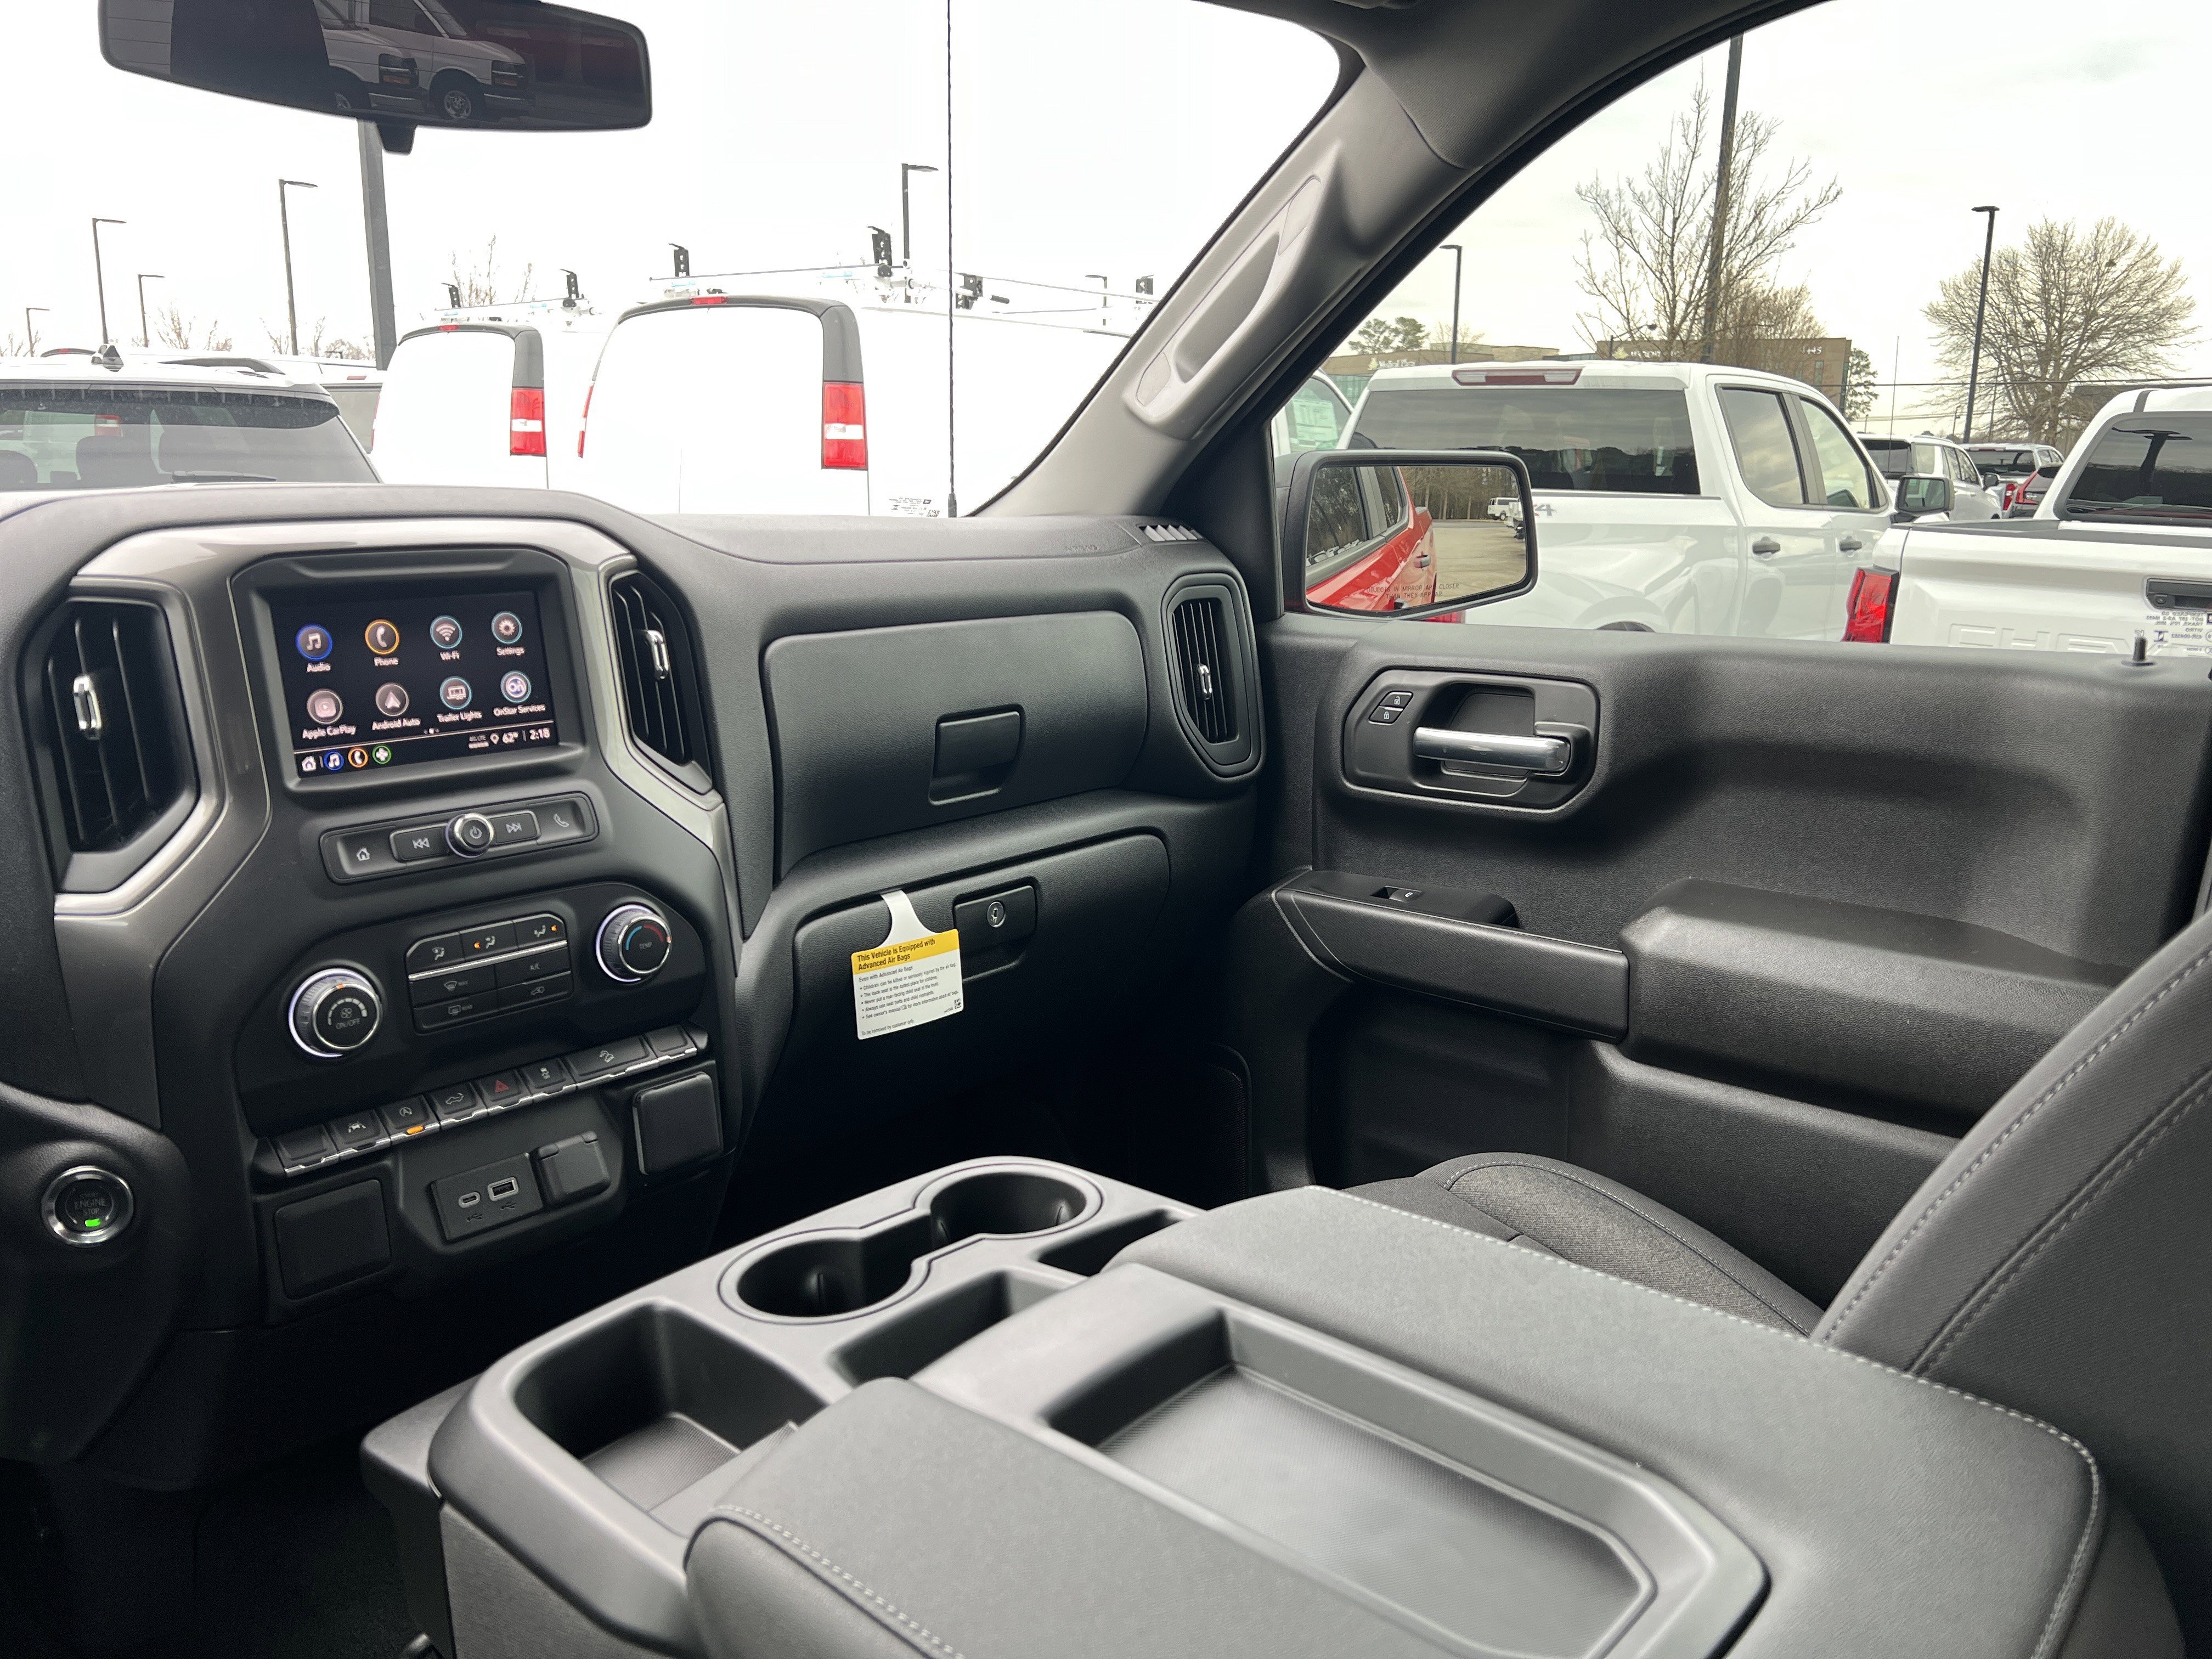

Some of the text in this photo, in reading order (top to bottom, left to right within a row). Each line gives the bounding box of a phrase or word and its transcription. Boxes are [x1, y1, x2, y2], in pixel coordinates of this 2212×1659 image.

[440, 651, 460, 661] Wi-Fi
[496, 646, 526, 657] Settings
[307, 662, 331, 673] Audio
[374, 657, 399, 667] Phone
[437, 710, 483, 723] Trailer Lights
[493, 704, 546, 717] OnStar Services
[372, 718, 421, 730] Android Auto
[302, 724, 357, 740] Apple CarPlay
[502, 731, 518, 744] 62°
[529, 727, 551, 741] 2:18
[639, 941, 653, 950] TEMP
[857, 953, 870, 962] This
[872, 949, 892, 959] Vehicle
[899, 941, 923, 953] Equipped
[924, 938, 936, 947] with
[858, 953, 911, 970] Advanced Air Bags
[335, 1018, 360, 1030] ON/OFF
[74, 1198, 106, 1210] ENGINE
[83, 1207, 100, 1216] STOP
